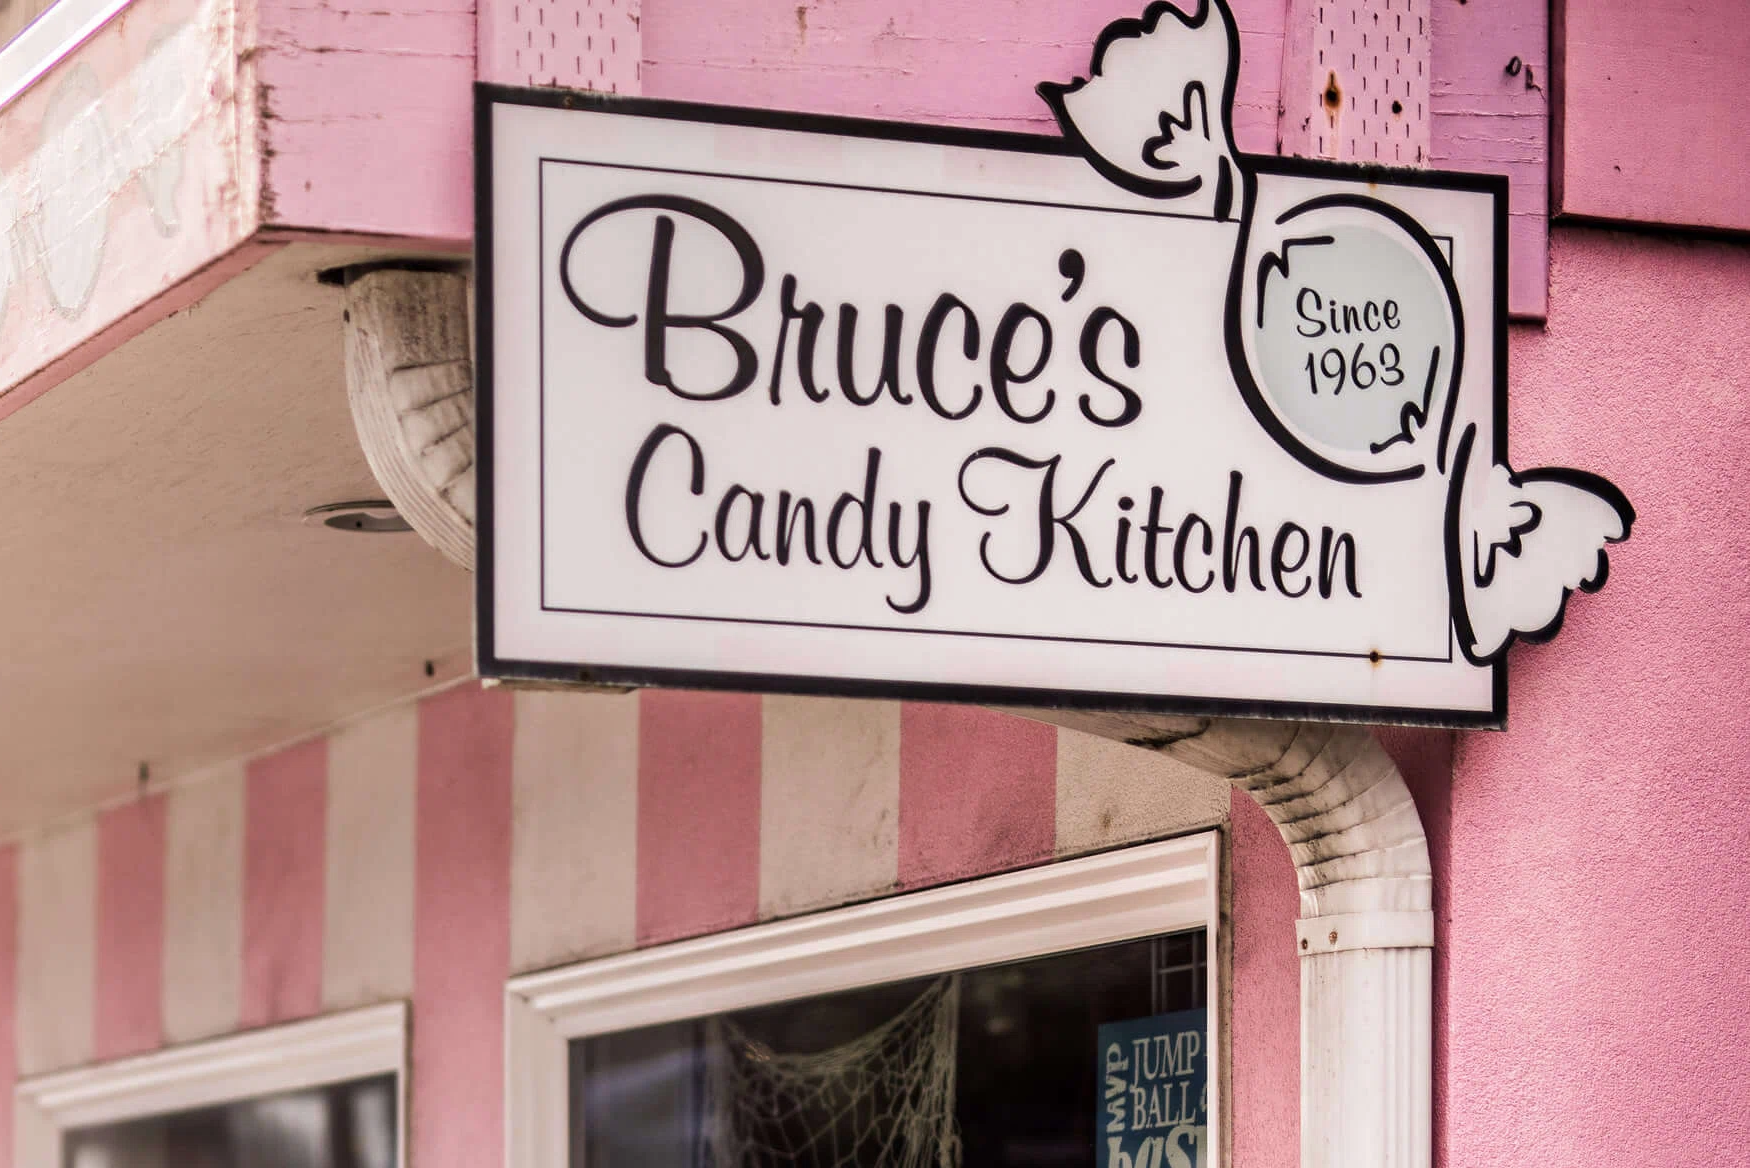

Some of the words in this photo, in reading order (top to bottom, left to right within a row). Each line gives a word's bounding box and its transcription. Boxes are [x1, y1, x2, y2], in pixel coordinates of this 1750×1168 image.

[559, 193, 1143, 427] Bruce's
[1295, 287, 1401, 338] Since
[1303, 343, 1405, 394] 1963
[625, 423, 931, 614] Candy
[958, 447, 1362, 599] Kitchen
[1131, 1030, 1201, 1087] JUMP
[1106, 1042, 1129, 1134] MVP
[1131, 1079, 1196, 1131] BALL
